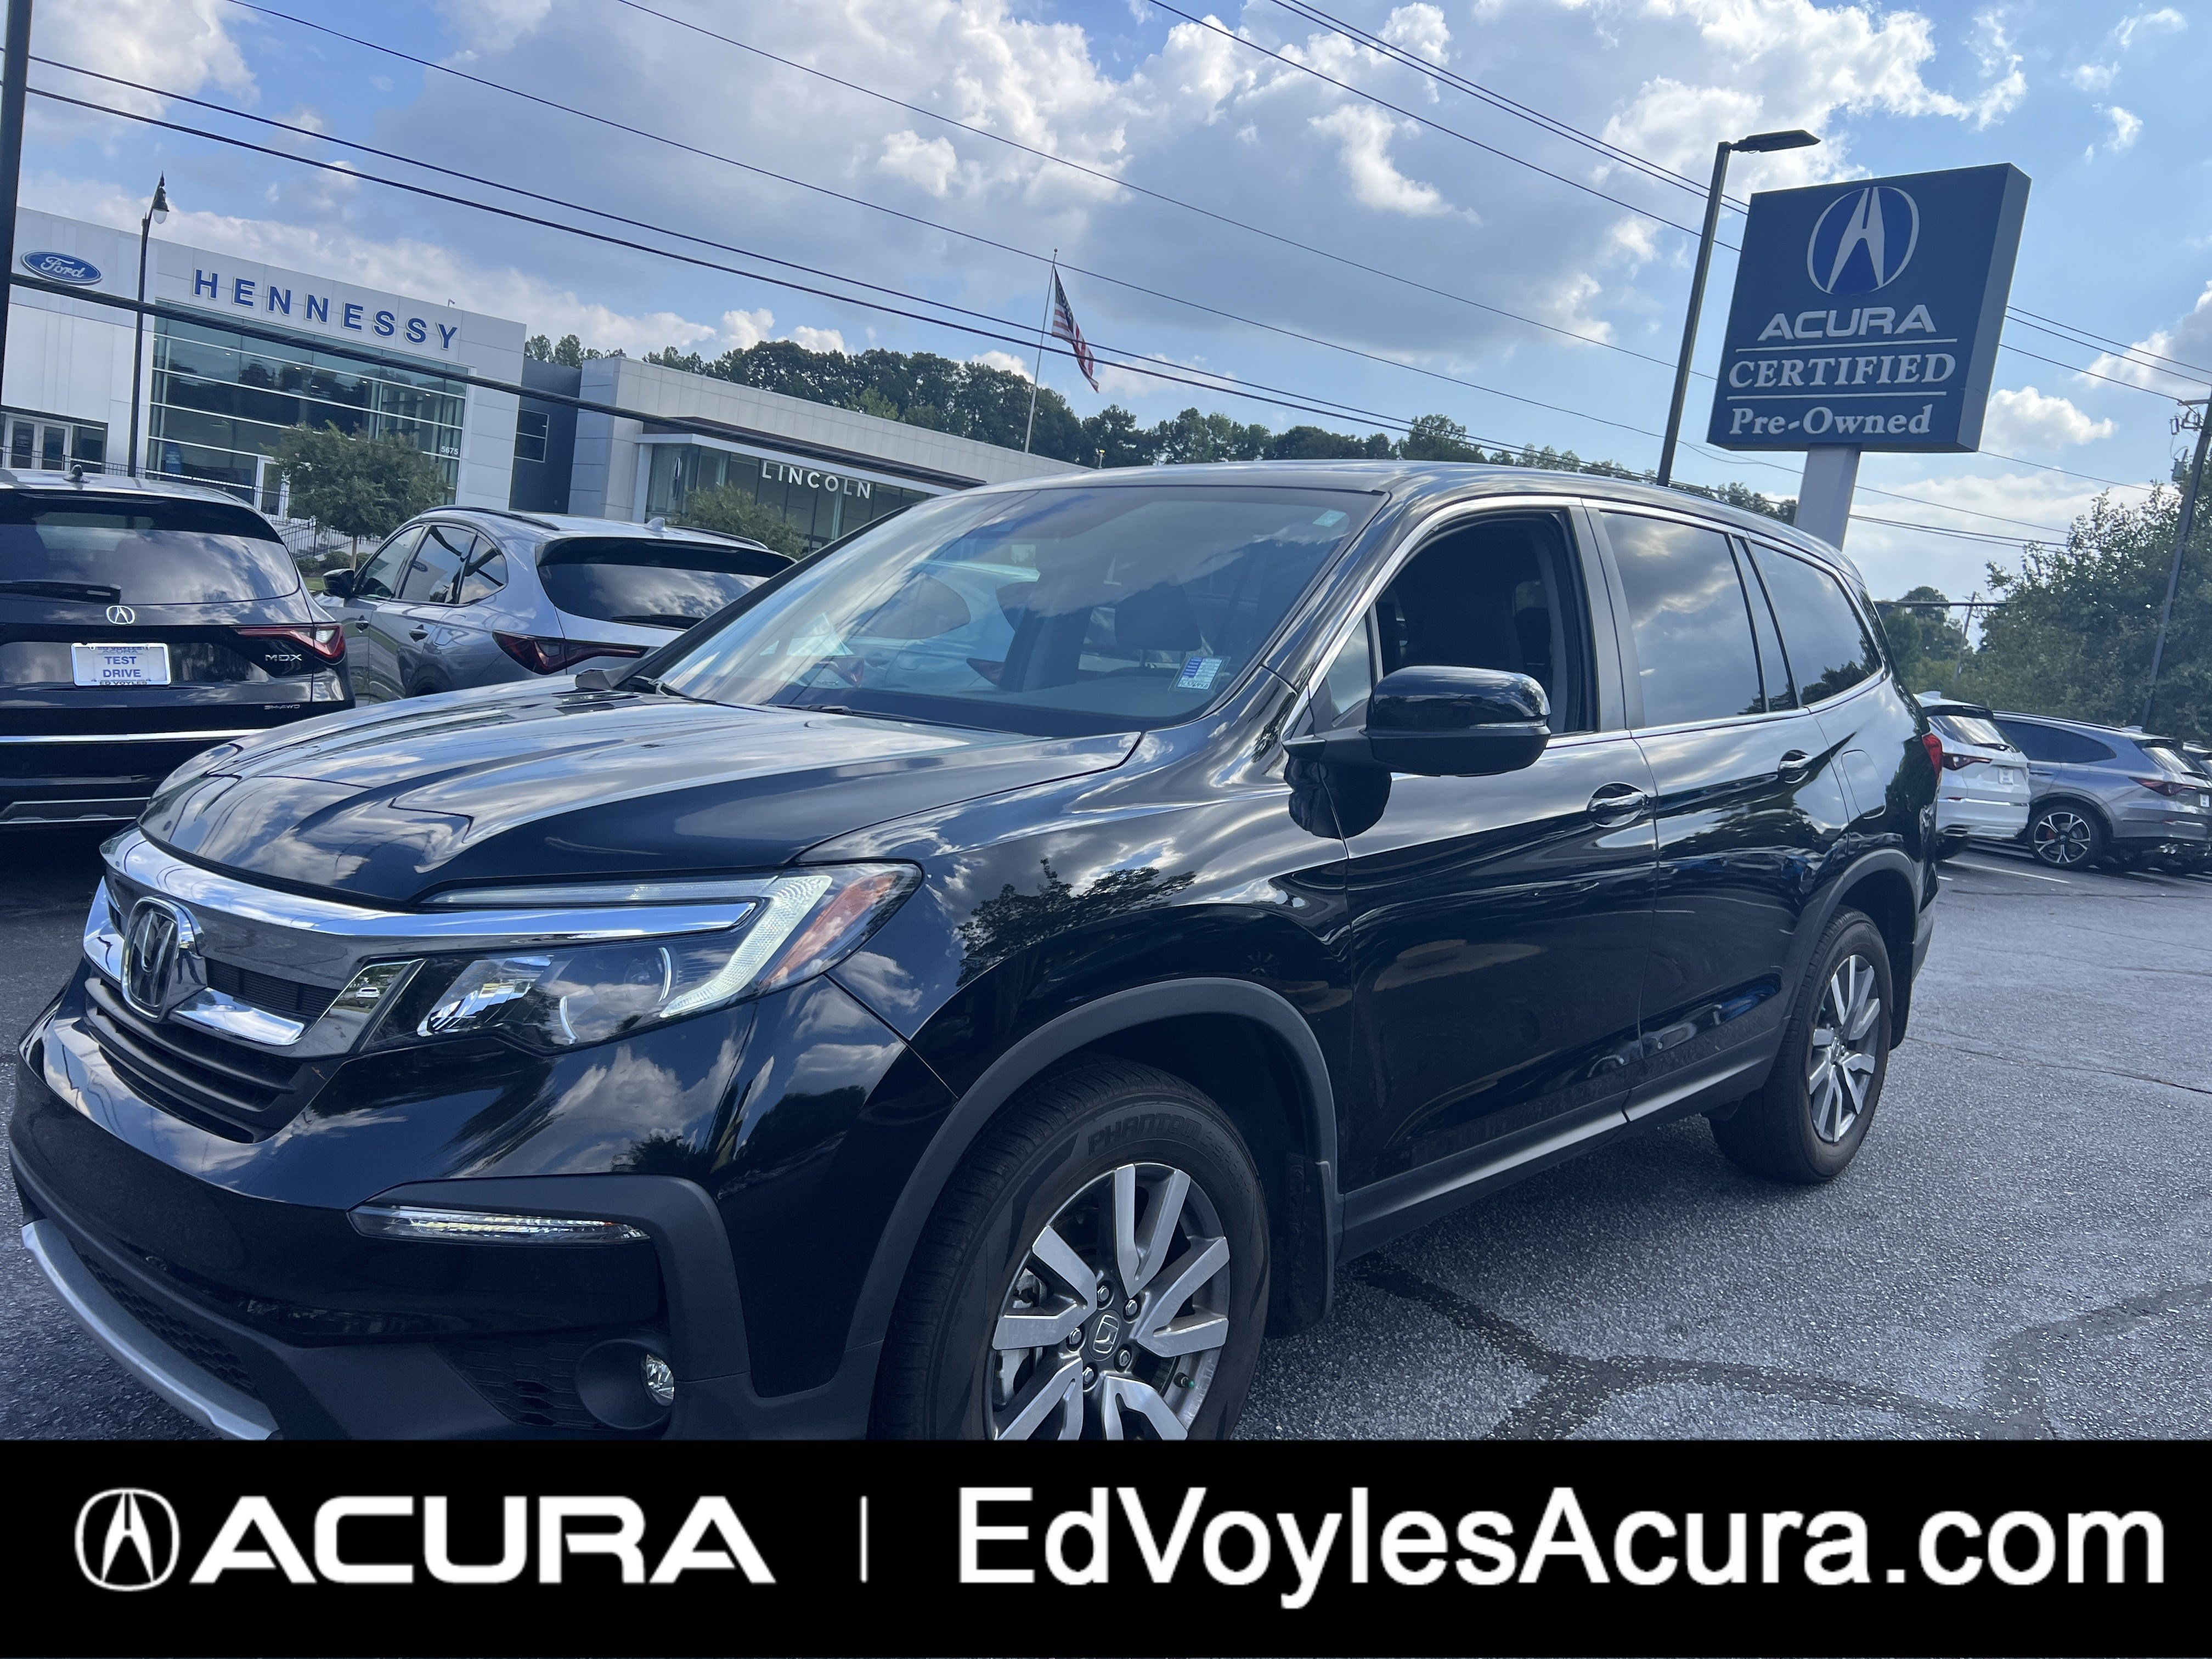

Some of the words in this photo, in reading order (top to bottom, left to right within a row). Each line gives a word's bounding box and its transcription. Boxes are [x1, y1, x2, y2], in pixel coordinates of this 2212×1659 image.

[40, 256, 86, 278] Ford
[193, 267, 459, 351] HENNESSY
[1757, 304, 1937, 341] ACURA
[1728, 353, 1956, 389] CERTIFIED
[1729, 404, 1933, 436] Pre-Owned
[441, 445, 459, 455] 5675
[761, 461, 871, 499] LINCOLN
[103, 669, 142, 678] DRIVE
[104, 656, 137, 665] TEST
[1087, 1113, 1203, 1156] PHANTOM
